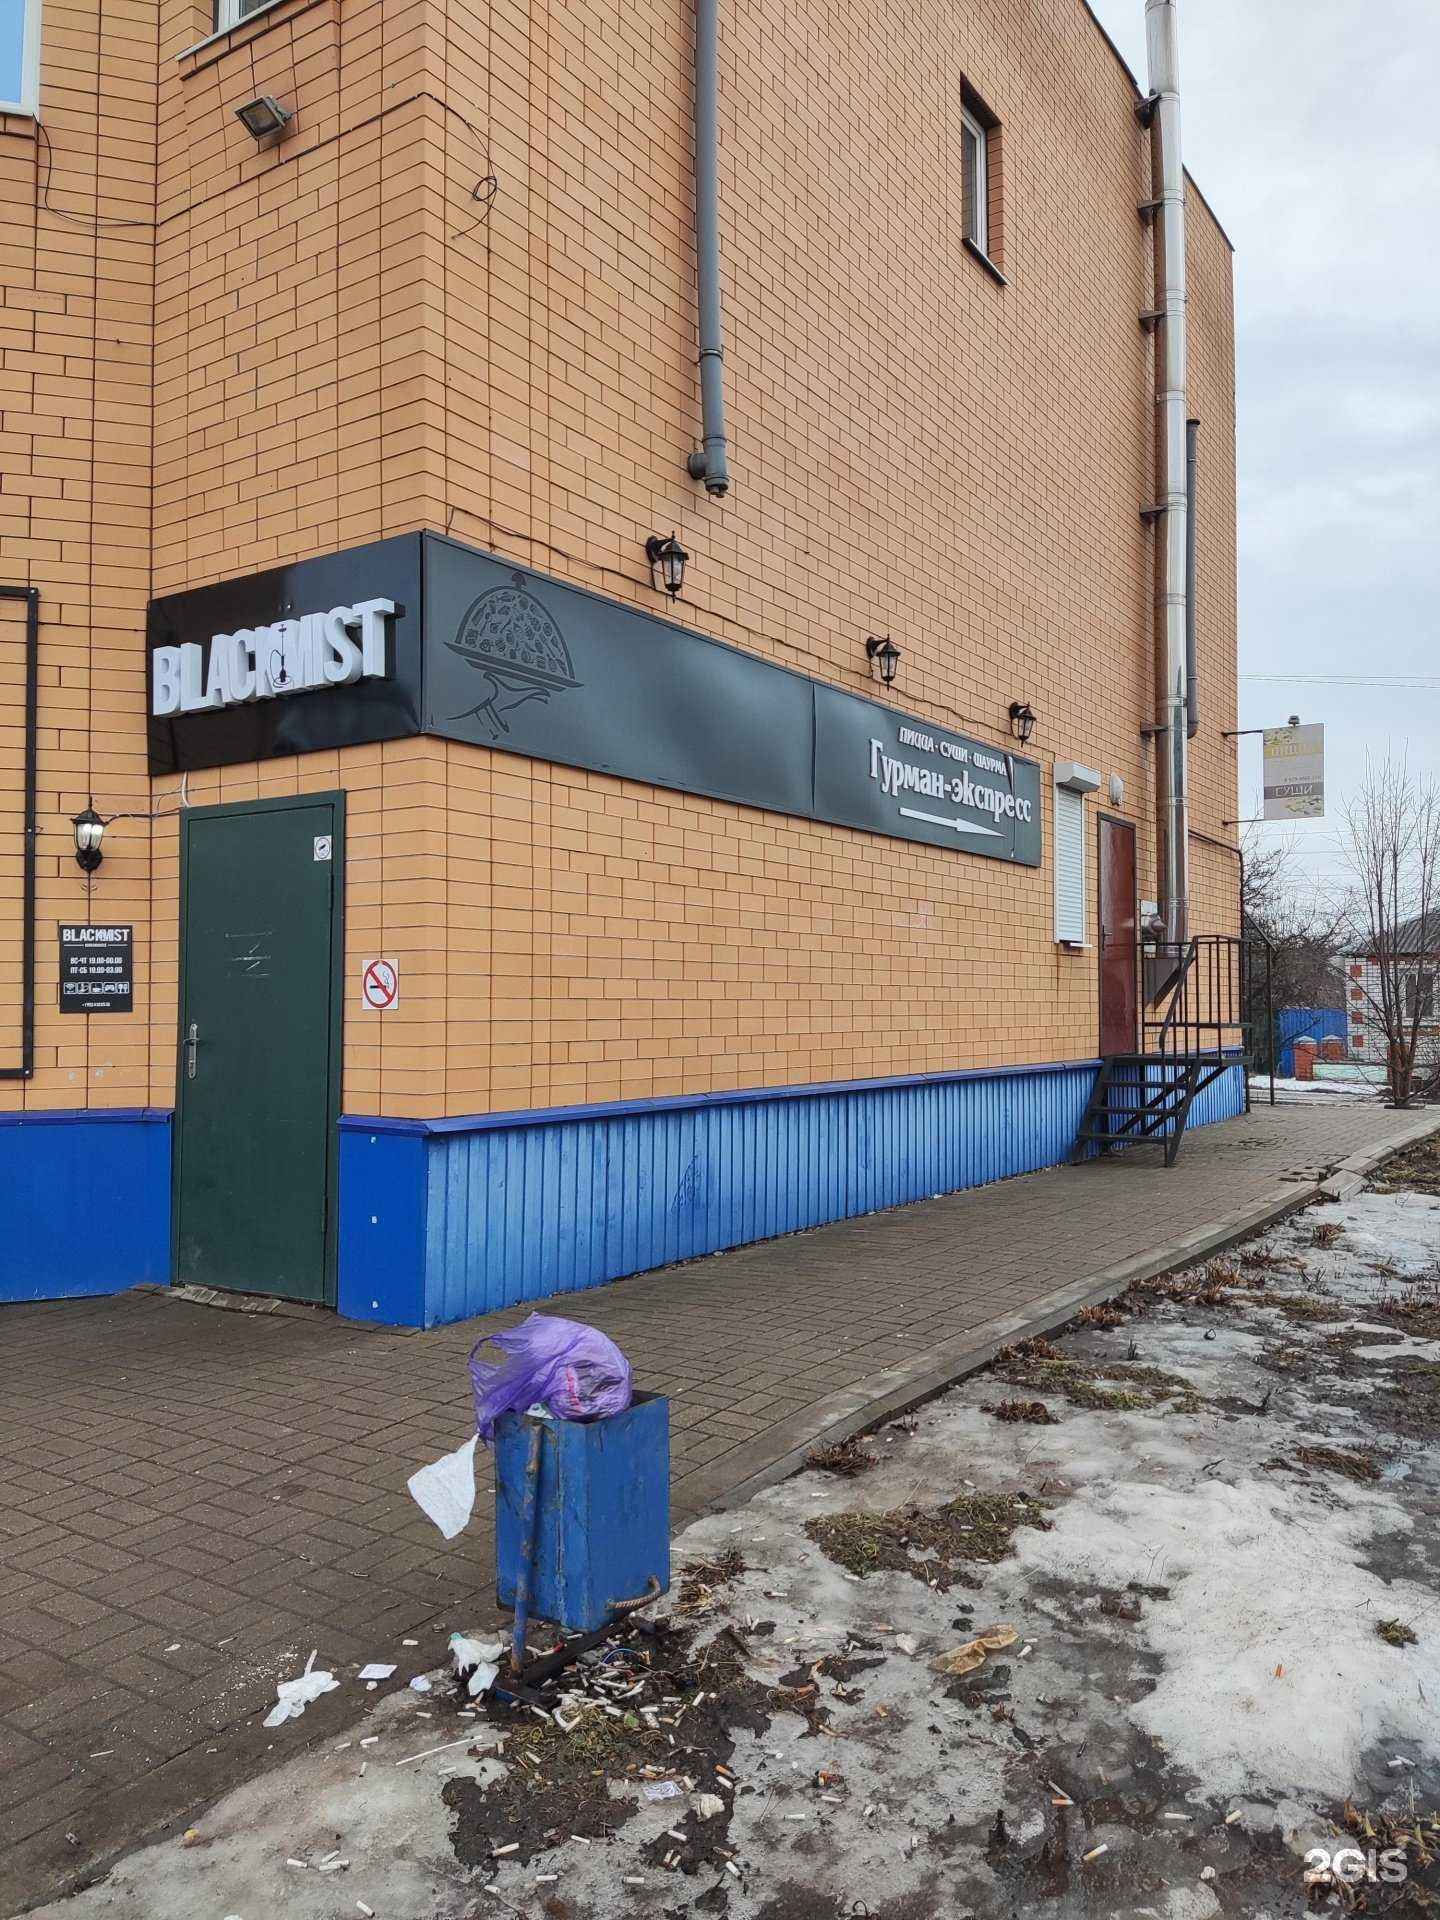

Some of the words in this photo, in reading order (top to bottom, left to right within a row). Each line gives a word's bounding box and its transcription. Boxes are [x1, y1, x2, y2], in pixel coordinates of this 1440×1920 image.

[899, 726, 935, 753] ПИЦЦА
[940, 742, 968, 763] СУШИ
[973, 752, 1007, 776] ШАУРМА
